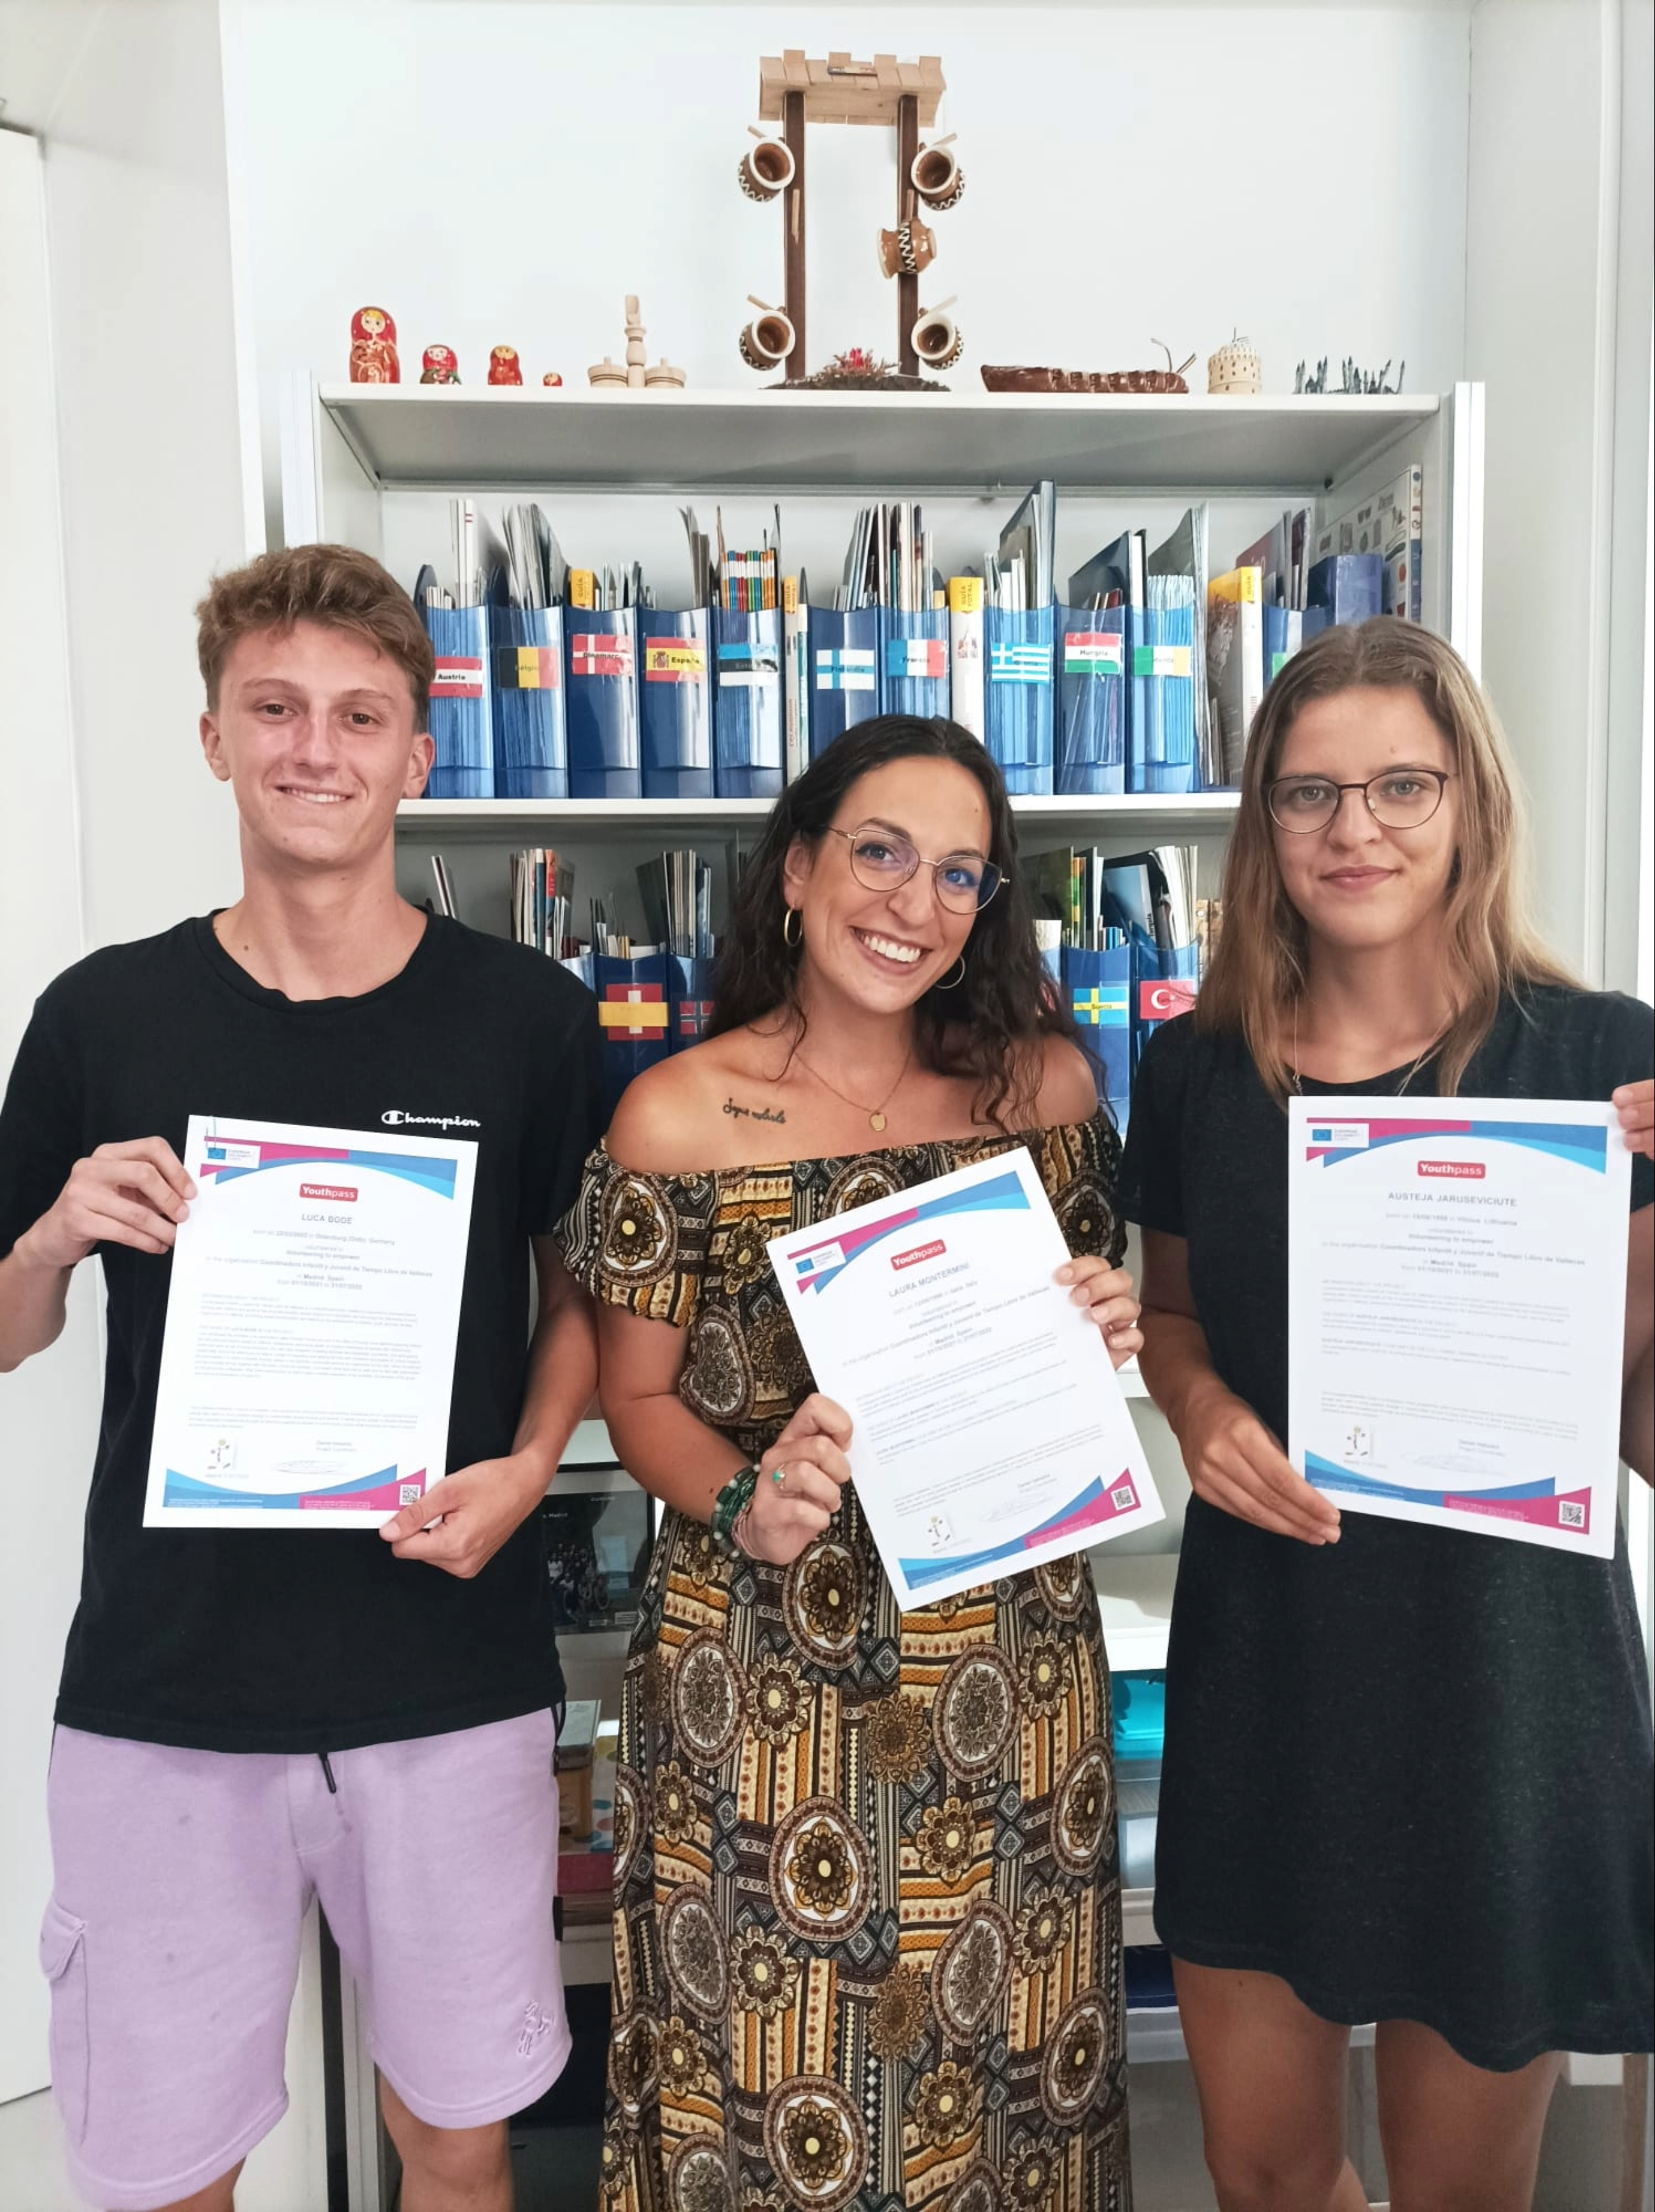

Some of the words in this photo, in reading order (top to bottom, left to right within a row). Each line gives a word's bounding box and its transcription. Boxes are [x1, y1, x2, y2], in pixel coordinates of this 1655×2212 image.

[381, 1110, 481, 1130] Champion
[1420, 1163, 1482, 1176] Youthpass
[302, 1186, 355, 1199] Youthpass
[1388, 1191, 1433, 1201] AUSTEJA
[1436, 1194, 1517, 1206] JARUSEVICIUTE
[301, 1214, 325, 1222] LUCA
[328, 1215, 353, 1224] BODE
[893, 1245, 943, 1266] Youthpass
[888, 1282, 918, 1298] LAURA
